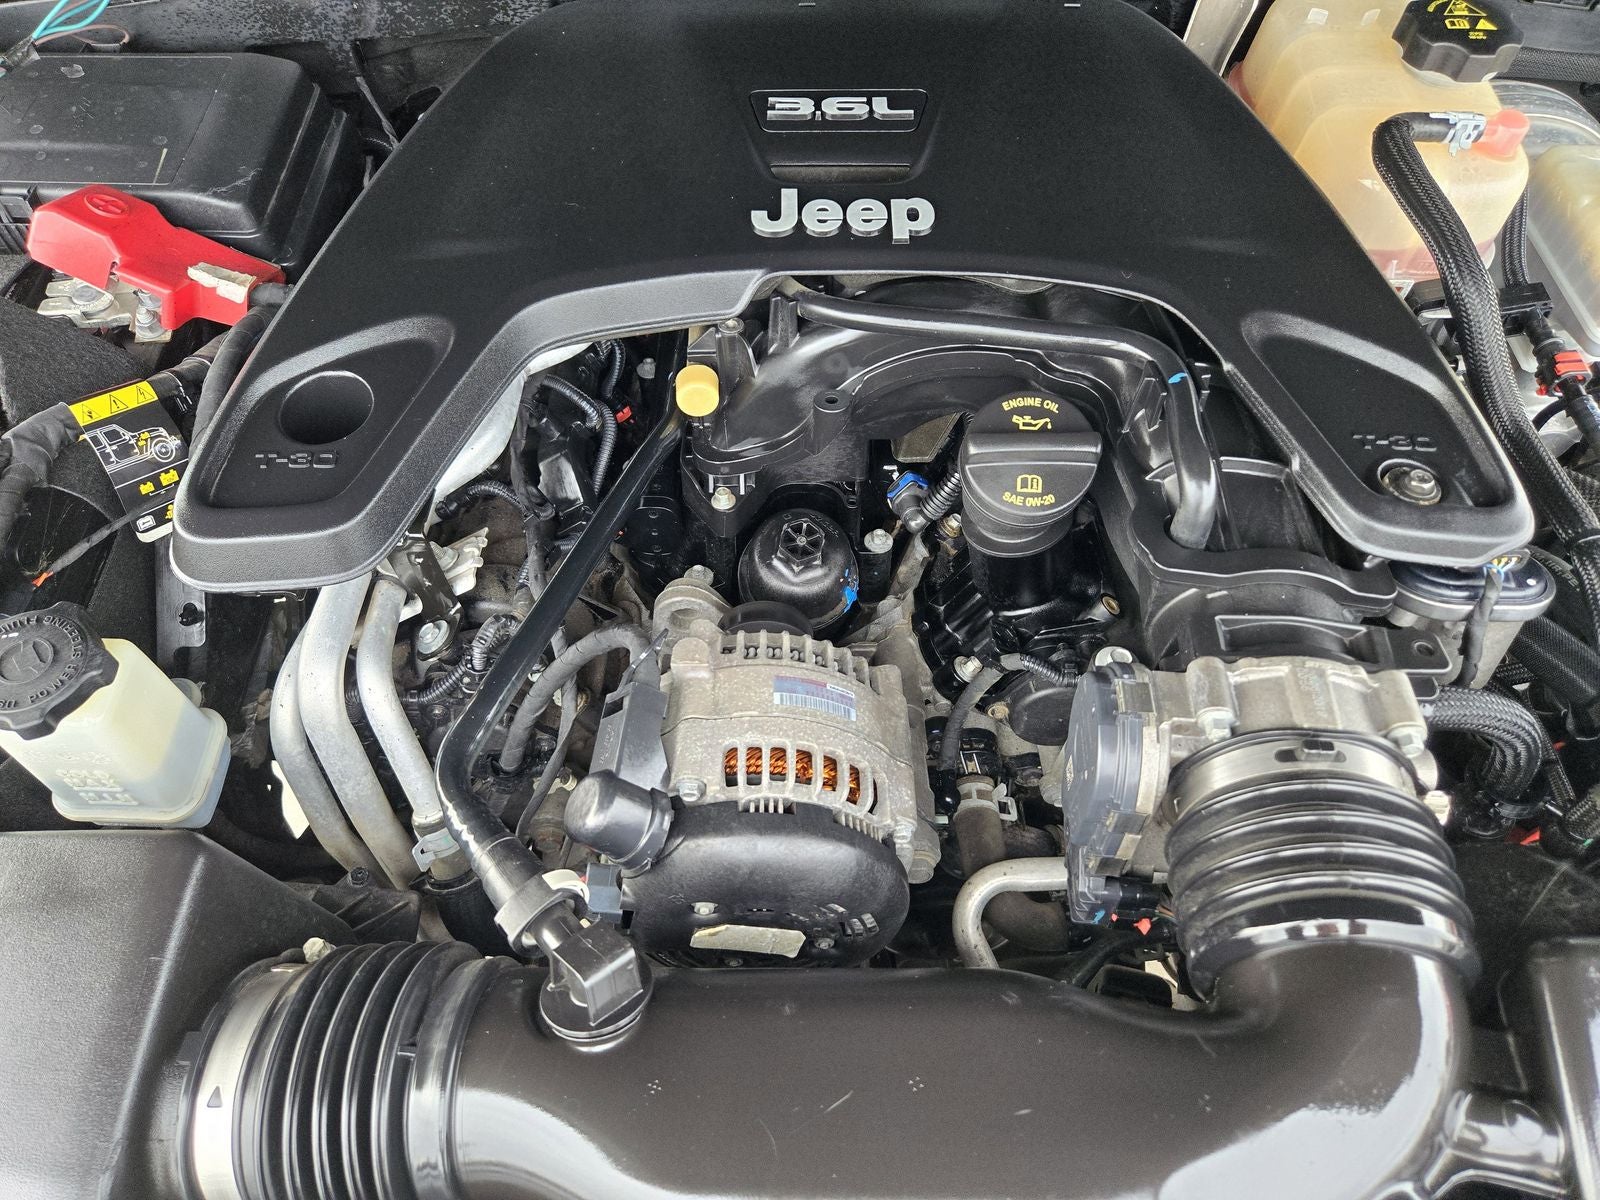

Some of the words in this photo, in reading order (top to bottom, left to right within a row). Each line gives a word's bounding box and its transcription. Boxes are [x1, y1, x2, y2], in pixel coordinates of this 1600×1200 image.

[767, 97, 914, 120] 3.6L
[751, 188, 935, 244] Jeep
[1001, 397, 1042, 411] ENGINE
[1043, 398, 1059, 413] OIL
[1352, 433, 1437, 452] T-30
[254, 450, 336, 469] T-30
[1002, 491, 1023, 506] SAE
[1025, 493, 1055, 507] 0W-20
[43, 615, 82, 660] STEERING
[27, 663, 77, 703] POWER
